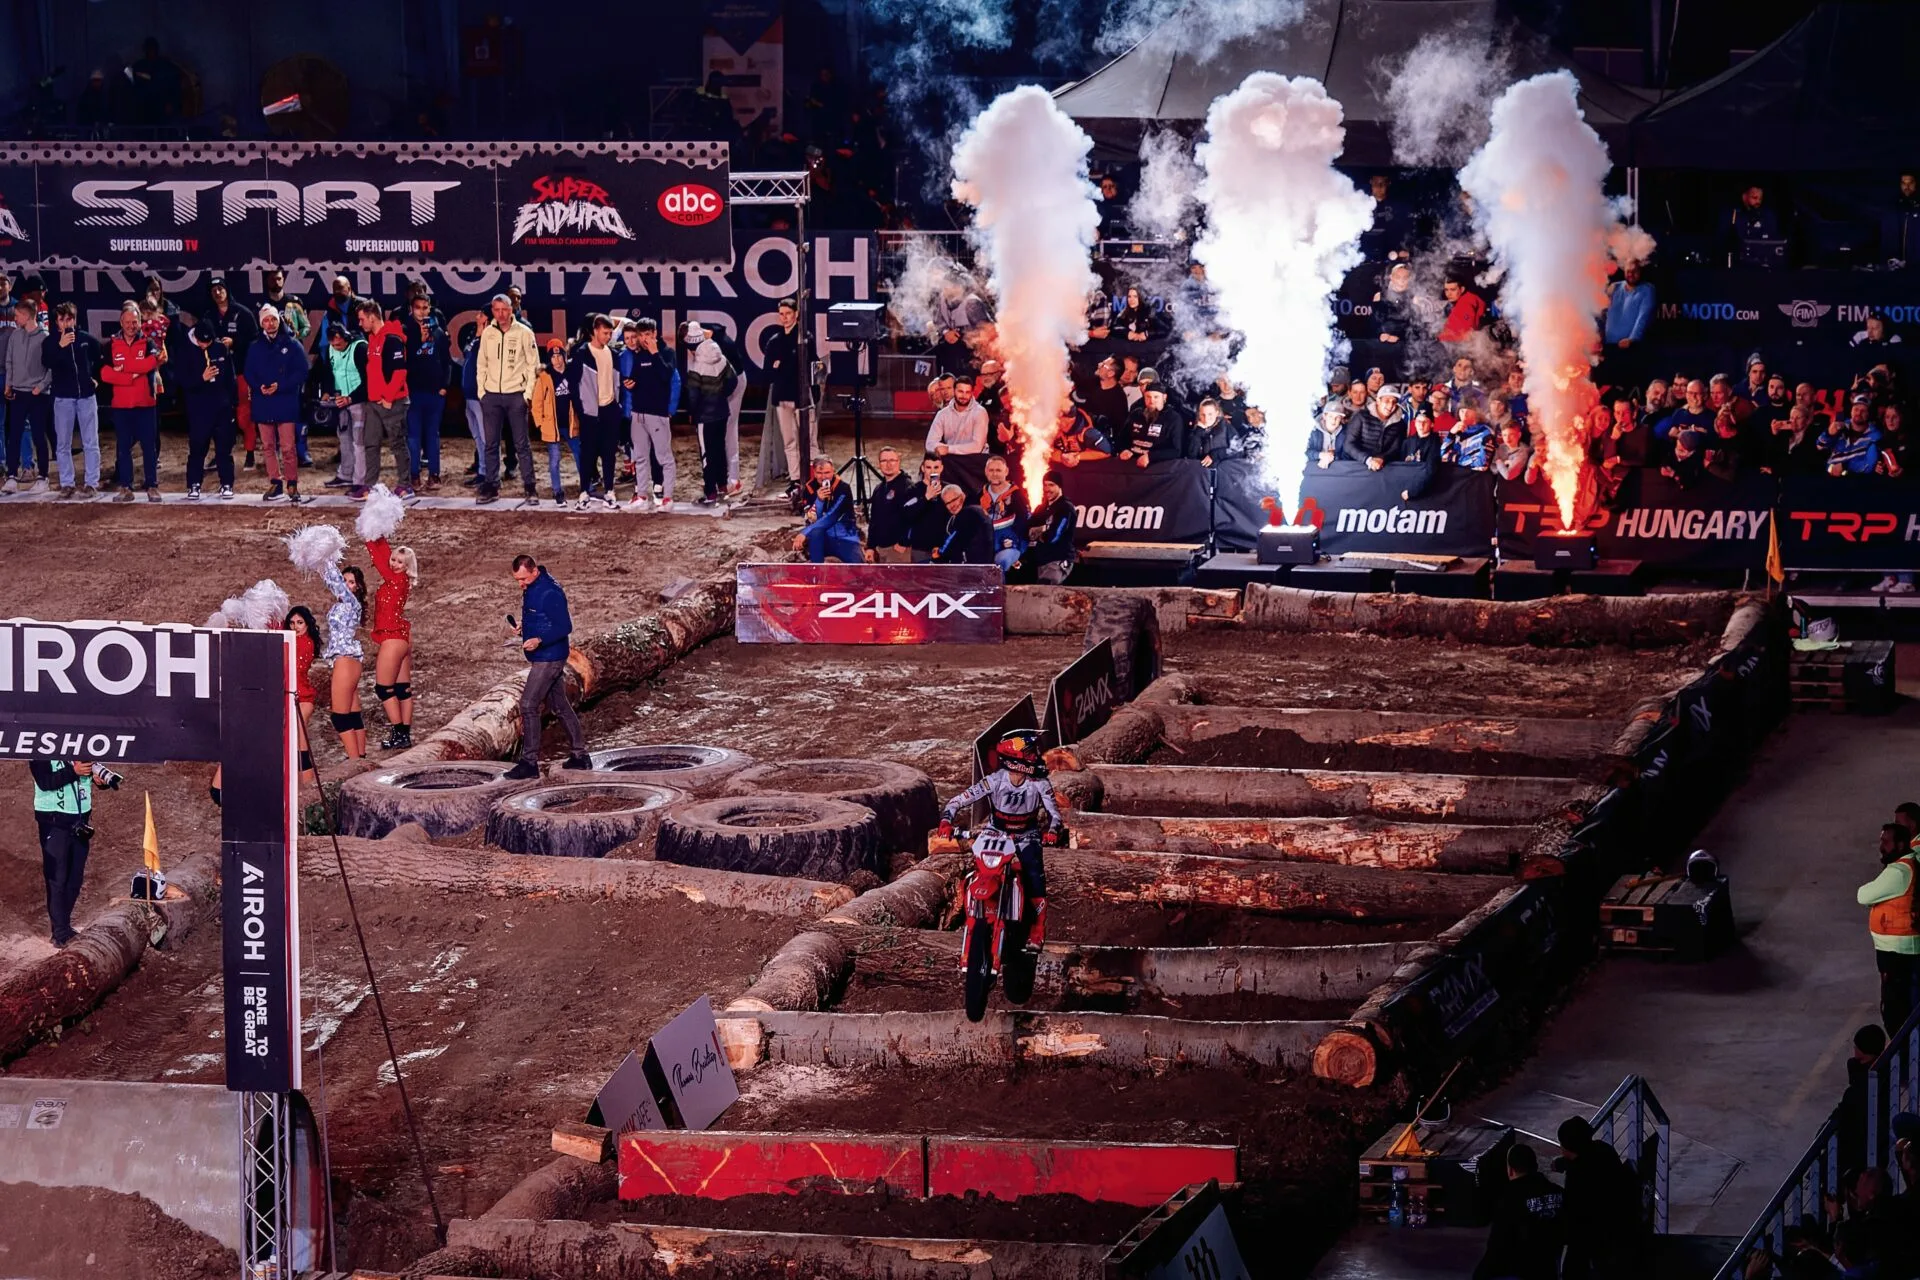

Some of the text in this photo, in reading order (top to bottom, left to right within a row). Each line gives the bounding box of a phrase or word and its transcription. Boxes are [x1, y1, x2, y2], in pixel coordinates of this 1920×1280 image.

[72, 180, 461, 226] START
[532, 176, 609, 203] SUPER
[665, 187, 717, 212] abc
[511, 202, 635, 245] ENDURO
[110, 239, 199, 252] SUPERENDURO TV
[345, 239, 435, 252] SUPERENDURO TV
[1336, 502, 1448, 534] motam
[1616, 508, 1770, 540] HUNGARY
[1790, 511, 1897, 541] TRP
[818, 592, 981, 619] 24MX
[1074, 671, 1113, 724] 24MX
[983, 839, 1007, 851] 111
[242, 861, 265, 960] AIROH
[243, 986, 257, 1057] BE GREAT
[255, 986, 269, 1057] DARE TO
